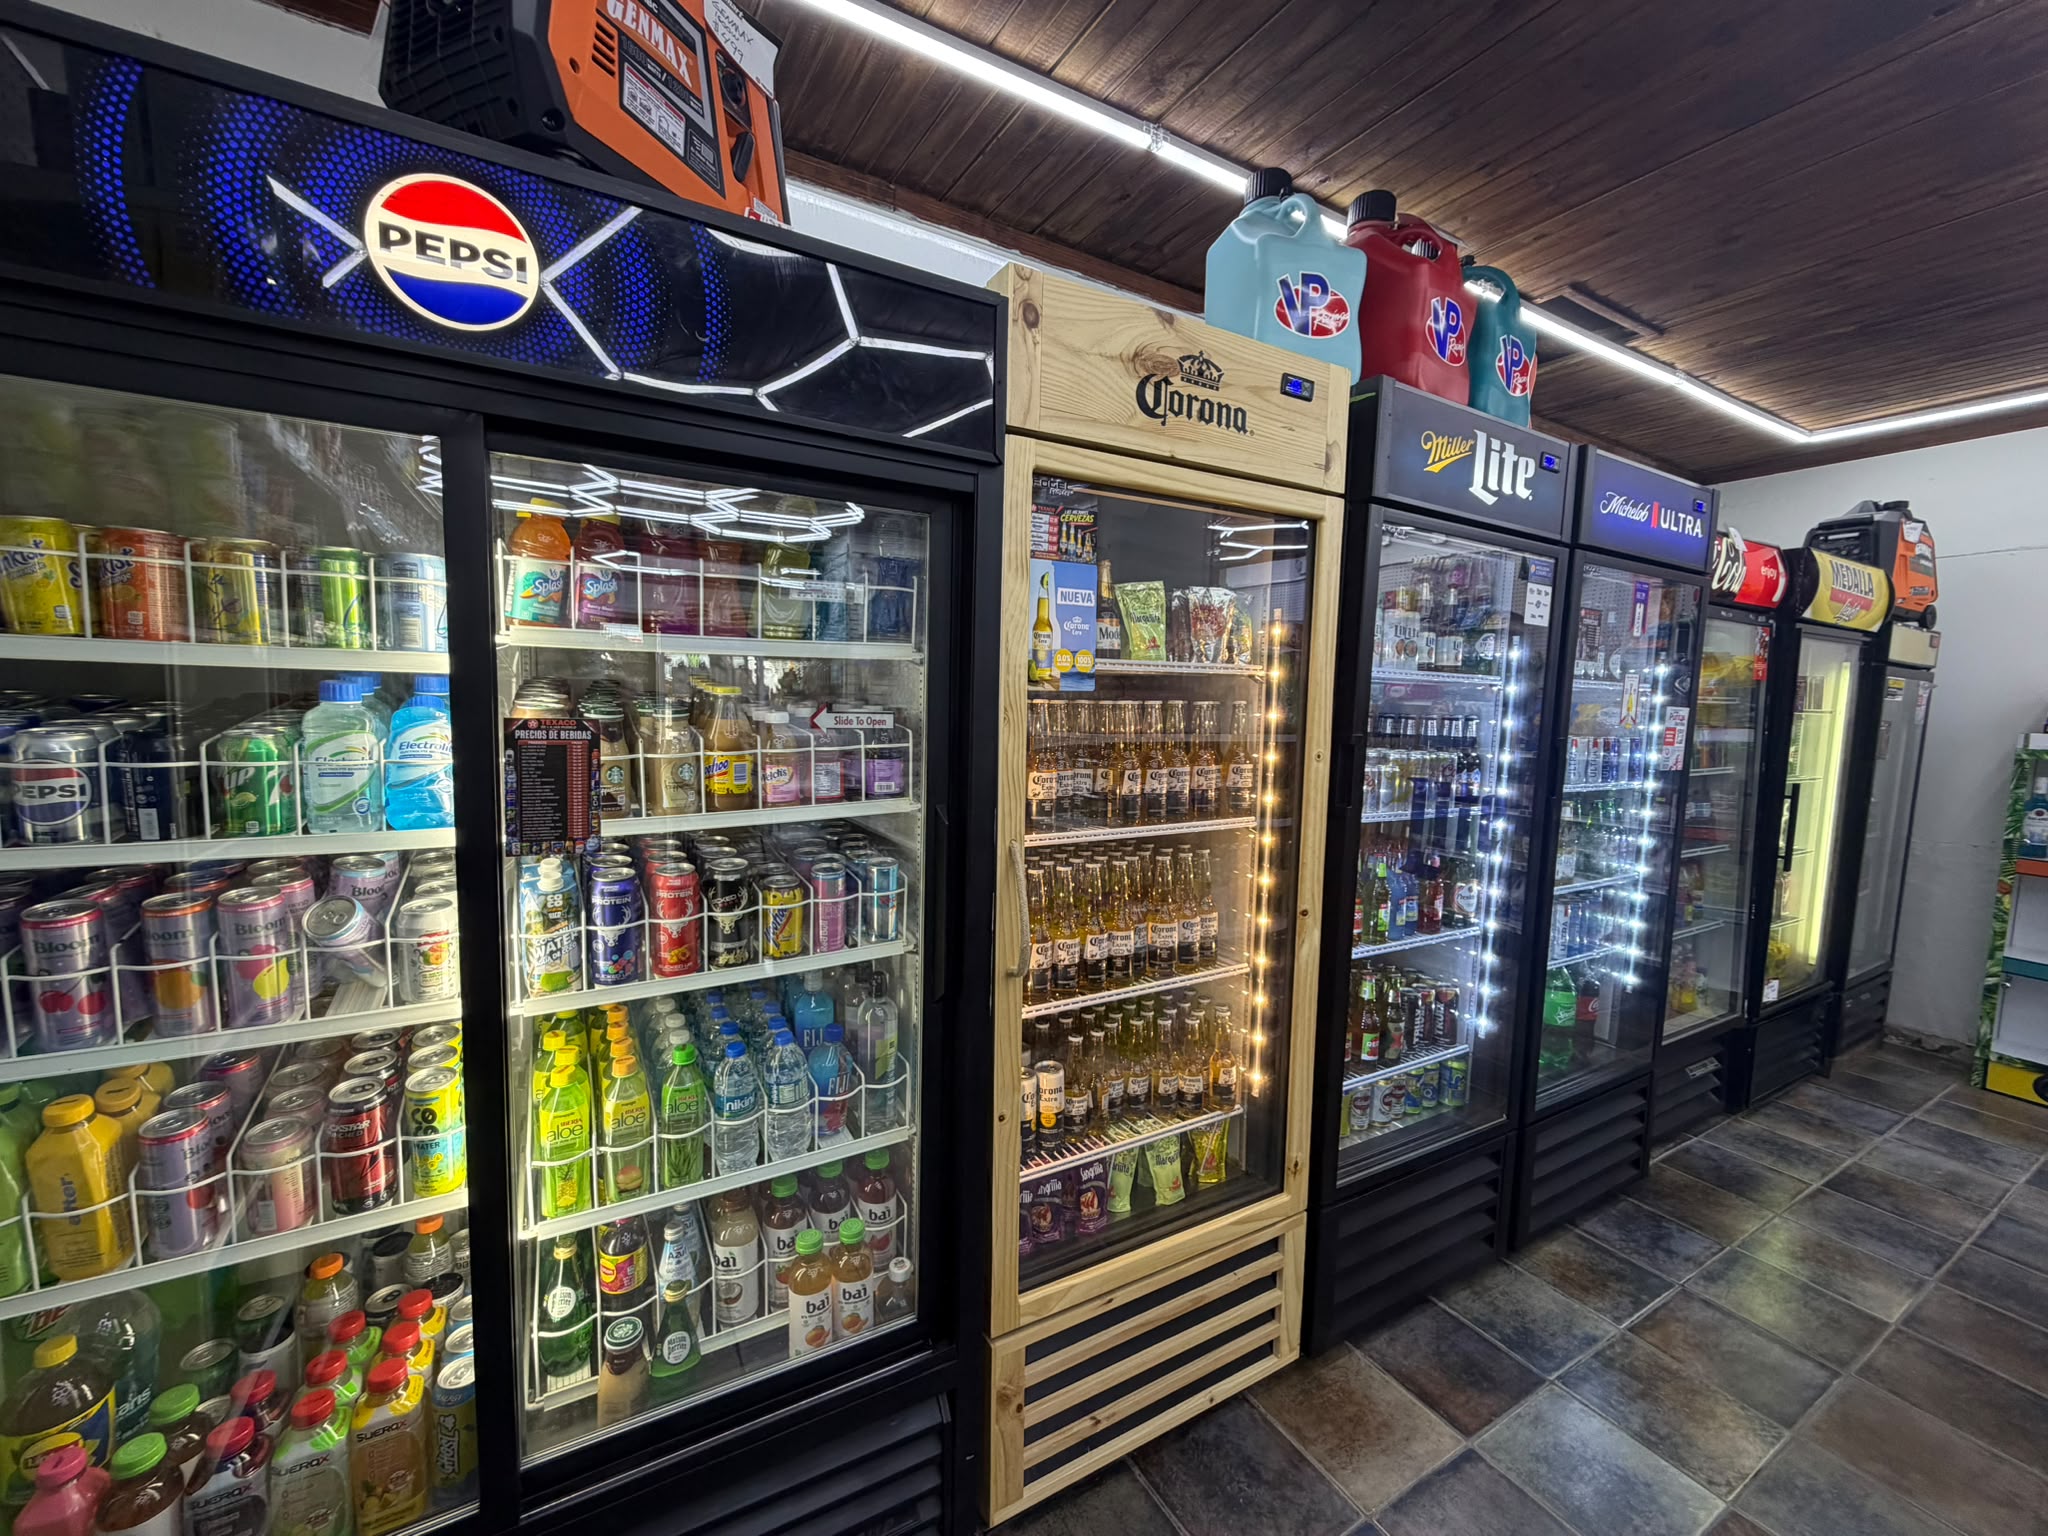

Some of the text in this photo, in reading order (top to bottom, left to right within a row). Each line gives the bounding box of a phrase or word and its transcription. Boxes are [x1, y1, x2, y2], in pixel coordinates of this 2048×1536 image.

[605, 0, 693, 88] GENMAX
[378, 221, 528, 284] PEPSI
[1277, 271, 1330, 338] VP
[1430, 296, 1462, 362] VP
[1499, 334, 1525, 392] VP
[1136, 373, 1250, 435] Corona
[1420, 428, 1536, 506] Miller Lite
[1060, 514, 1095, 523] CERVEZAS
[1599, 491, 1704, 538] Michelob ULTRA
[0, 540, 45, 575] nkist
[1760, 565, 1778, 580] enjoy
[1830, 559, 1875, 599] MEDALLA
[585, 579, 617, 595] Splash
[1060, 589, 1094, 605] NUEVA
[1063, 620, 1090, 632] Corona
[1099, 626, 1121, 641] Mod
[1077, 656, 1092, 665] 100%
[833, 715, 887, 727] Slide To Open
[514, 730, 592, 741] PRECIOS DE BEBIDAS
[399, 740, 452, 753] Electroli
[223, 766, 256, 789] UP
[1032, 774, 1057, 786] Coro
[1073, 771, 1092, 780] orona
[351, 883, 387, 899] Bloo
[547, 893, 564, 901] CO
[656, 889, 694, 899] PROTEIN
[547, 900, 564, 908] CO
[591, 896, 632, 905] PROTEIN
[233, 915, 287, 937] Bloom
[1150, 924, 1177, 934] Coron
[33, 933, 100, 954] Bloom
[152, 928, 193, 942] oom
[533, 929, 579, 958] WATER
[803, 1028, 824, 1047] FIJ
[827, 1072, 850, 1096] FIJI
[1039, 1086, 1063, 1095] orona
[664, 1098, 699, 1114] aloe
[611, 1111, 647, 1130] aloe
[546, 1124, 584, 1143] aloe
[868, 1205, 892, 1222] bai
[842, 1283, 868, 1301] bai
[805, 1292, 831, 1315] bai
[356, 1418, 408, 1443] SUEROX
